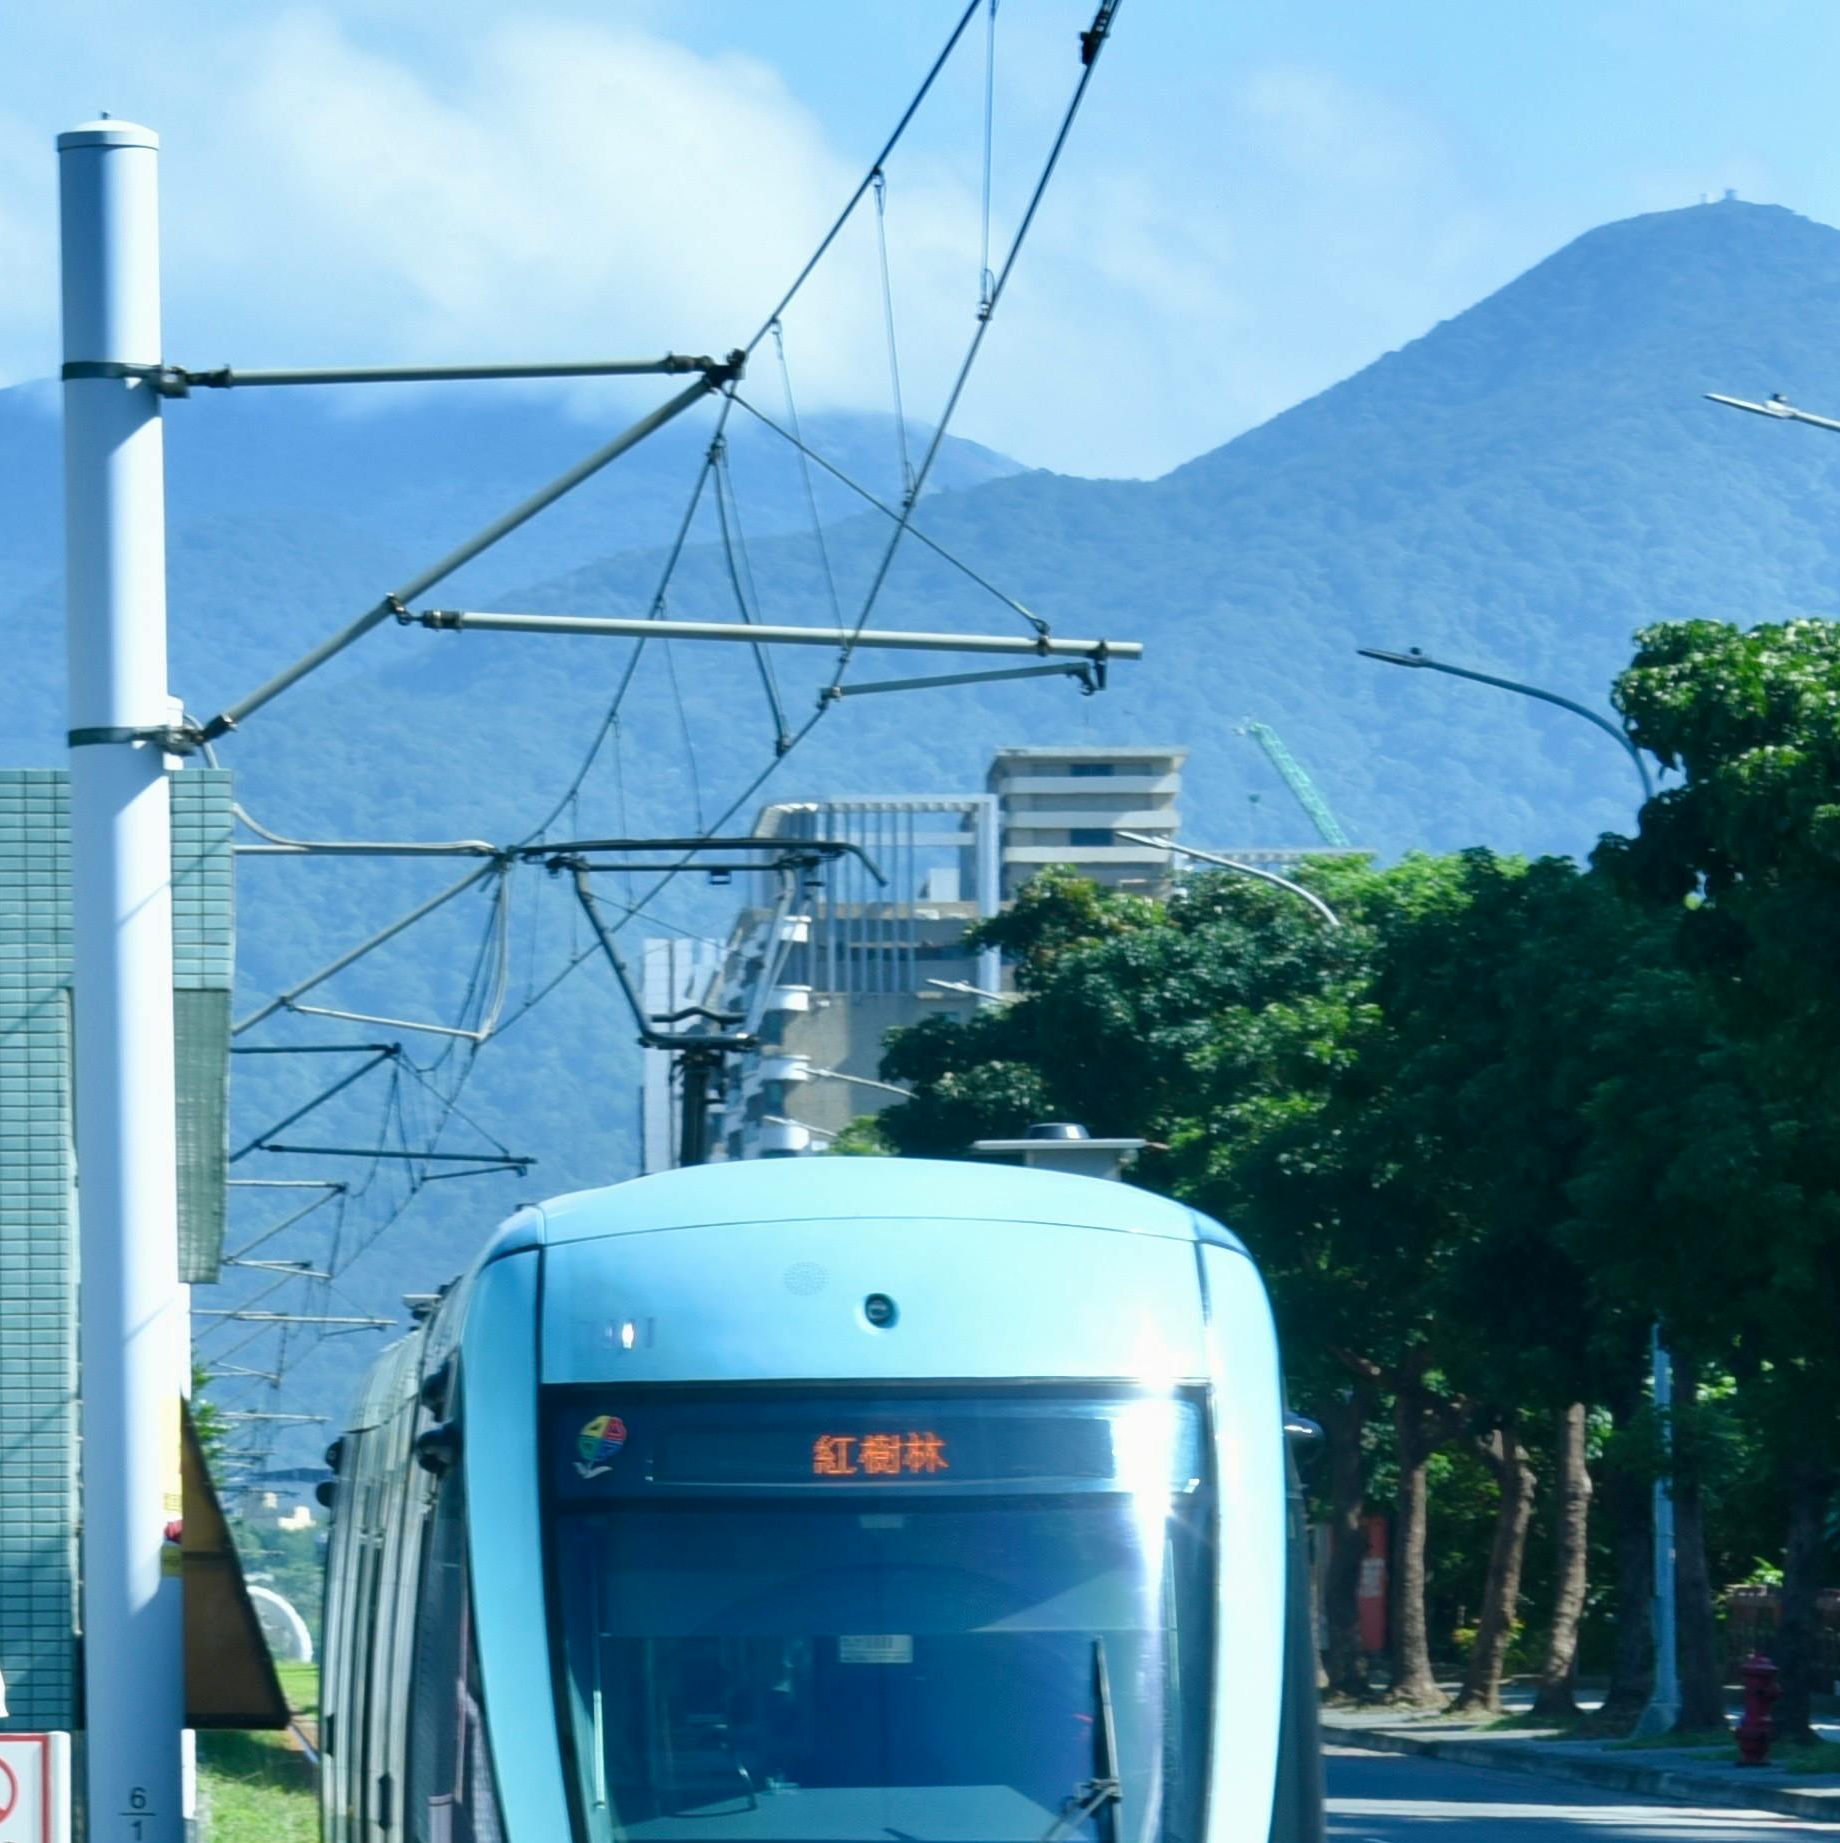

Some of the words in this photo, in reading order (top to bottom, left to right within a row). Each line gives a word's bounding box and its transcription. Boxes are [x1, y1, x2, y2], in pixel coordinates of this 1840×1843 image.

[812, 1432, 950, 1475] 紅樹林
[129, 1787, 146, 1809] 6
[131, 1820, 143, 1841] 1
